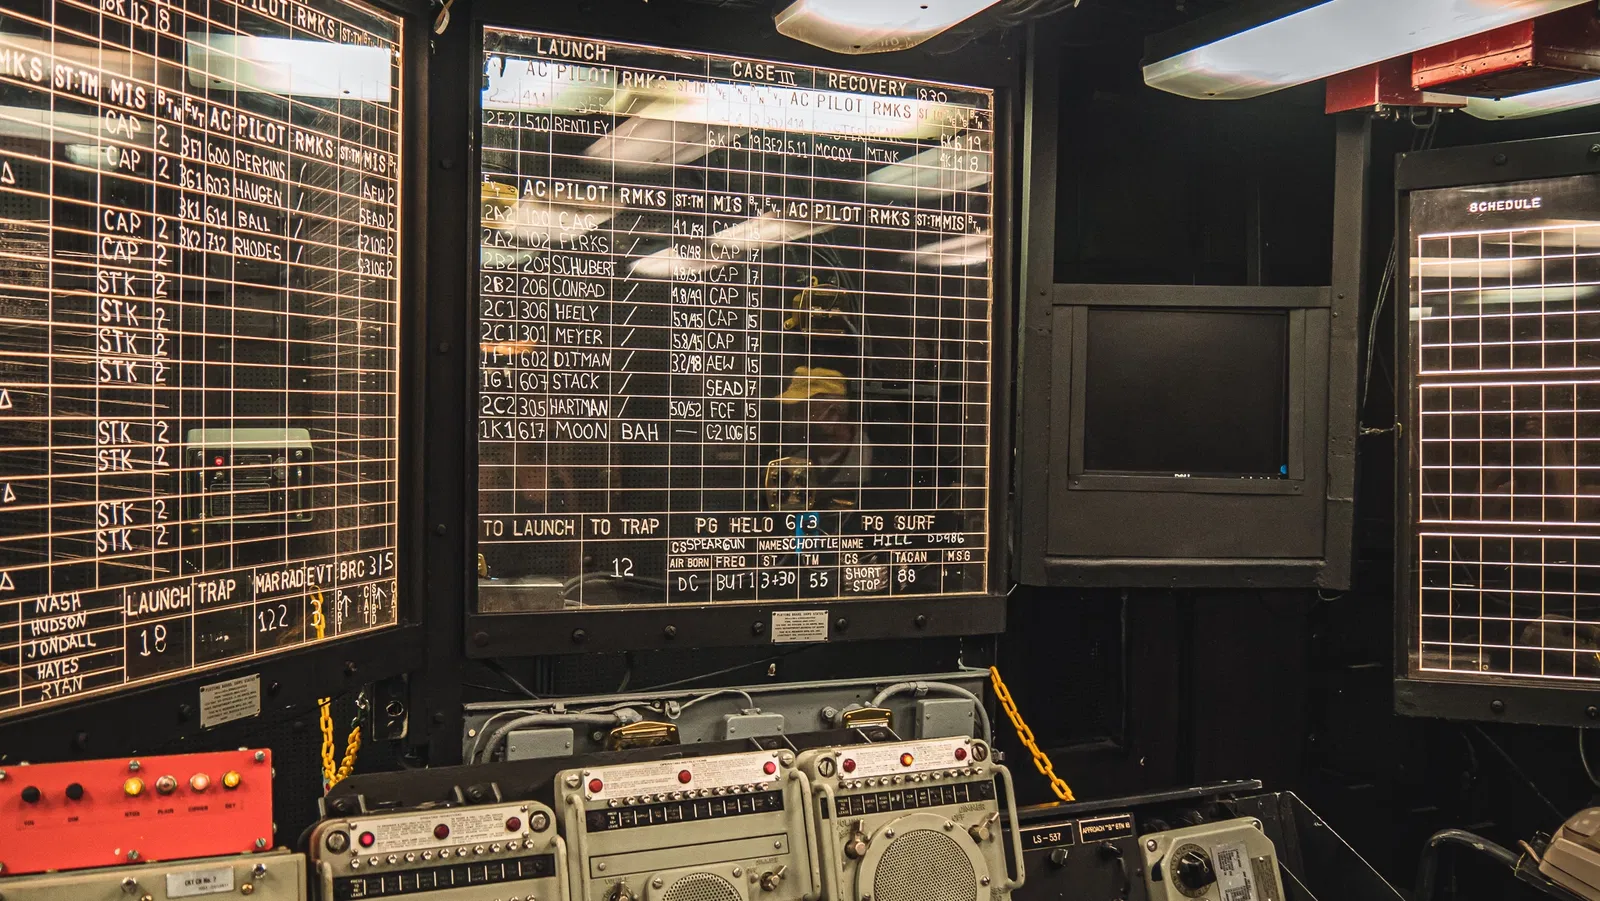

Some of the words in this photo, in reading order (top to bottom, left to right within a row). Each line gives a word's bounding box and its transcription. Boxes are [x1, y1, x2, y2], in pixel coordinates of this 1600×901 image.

[160, 9, 170, 32] 8
[297, 8, 335, 39] RMKS
[537, 37, 607, 62] LAUNCH
[733, 61, 775, 82] CASE
[829, 72, 907, 97] RECOVERY
[526, 60, 548, 78] AC
[558, 64, 610, 85] PILOT
[623, 71, 668, 89] RMKS
[791, 92, 809, 107] AC
[817, 94, 862, 113] PILOT
[873, 101, 912, 119] RMKS
[55, 64, 98, 97] ST:TM
[110, 79, 146, 109] MIS
[210, 108, 231, 131] AC
[239, 115, 285, 145] PILOT
[295, 131, 333, 158] RMKS
[340, 146, 361, 166] ST:TM
[364, 152, 386, 173] MIS
[106, 110, 141, 139] CAP
[157, 125, 169, 147] 2
[208, 143, 230, 166] 600
[236, 150, 285, 181] PERKINS
[526, 114, 550, 132] 510
[816, 143, 853, 163] MCCOY
[867, 147, 899, 163] MTNK
[970, 156, 979, 172] 8
[107, 146, 141, 172] CAP
[159, 157, 169, 179] 2
[206, 174, 230, 196] 603
[234, 178, 283, 207] HAUGEN
[360, 208, 386, 228] SEAD
[524, 179, 546, 198] AC
[555, 181, 608, 202] PILOT
[621, 187, 667, 207] RMKS
[676, 194, 704, 209] ST:TM
[714, 196, 742, 213] MIS
[789, 202, 809, 218] AC
[815, 204, 862, 222] PILOT
[870, 208, 910, 227] RMKS
[917, 214, 941, 228] ST:TM
[943, 215, 965, 231] MIS
[239, 212, 271, 232] BALL
[485, 205, 513, 221] 2A2
[713, 220, 740, 240] CAP
[105, 210, 141, 234] CAP
[157, 217, 168, 239] 2
[208, 234, 229, 254] 712
[234, 237, 282, 261] RHODES
[484, 229, 515, 248] 2A2
[560, 233, 609, 254] FIRKS
[711, 243, 740, 261] CAP
[102, 238, 139, 264] CAP
[157, 245, 167, 266] 2
[484, 252, 517, 270] 2B2
[552, 255, 617, 277] SCHUBERT
[710, 265, 739, 283] CAP
[99, 271, 136, 296] STK
[156, 274, 168, 295] 2
[521, 277, 548, 296] 206
[553, 278, 606, 298] CONRAD
[710, 287, 739, 306] CAP
[101, 298, 139, 326] STK
[156, 308, 168, 331] 2
[484, 300, 516, 317] 2C1
[522, 301, 548, 320] 306
[556, 303, 599, 322] HEELY
[708, 309, 738, 327] CAP
[100, 329, 138, 354] STK
[157, 334, 168, 356] 2
[482, 322, 516, 342] 2C1
[522, 325, 547, 343] 301
[556, 327, 603, 345] MEYER
[708, 332, 735, 350] CAP
[100, 359, 138, 383] STK
[155, 362, 166, 383] 2
[521, 351, 548, 367] 602
[706, 355, 735, 372] AEW
[483, 371, 514, 389] 1G1
[520, 373, 548, 391] 607
[553, 373, 600, 390] STACK
[707, 379, 744, 397] SEAD
[482, 396, 517, 415] 2C2
[520, 397, 546, 417] 305
[550, 398, 609, 417] HARTMAN
[711, 401, 735, 419] FCF
[99, 421, 132, 445] STK
[157, 421, 170, 443] 2
[481, 420, 515, 439] 1K1
[519, 422, 546, 440] 617
[556, 421, 608, 440] MOON
[622, 423, 659, 442] BAH
[99, 449, 133, 471] STK
[156, 447, 169, 467] 2
[98, 502, 134, 528] STK
[155, 500, 168, 520] 2
[484, 520, 504, 537] TO
[513, 519, 575, 537] LAUNCH
[592, 519, 611, 535] TO
[621, 518, 660, 535] TRAP
[697, 518, 718, 534] PG
[732, 517, 774, 534] HELO
[786, 514, 818, 530] 613
[863, 516, 884, 531] PG
[896, 515, 936, 531] SURF
[97, 529, 133, 553] STK
[156, 525, 168, 546] 2
[782, 538, 839, 550] SCHOTTLE
[842, 539, 864, 549] NAME
[873, 534, 913, 547] HILL
[341, 560, 365, 581] BRC
[611, 558, 634, 578] 12
[687, 557, 710, 568] BORN
[716, 556, 746, 568] FREQ
[763, 556, 778, 567] ST
[805, 554, 820, 566] TM
[844, 553, 859, 565] CS
[895, 552, 928, 563] TACAN
[307, 564, 334, 587] EVT
[678, 574, 699, 592] DC
[716, 573, 745, 591] BUT
[761, 572, 796, 589] 3+30
[810, 572, 829, 588] 55
[845, 567, 881, 581] SHORT
[898, 569, 916, 583] 88
[853, 579, 881, 592] STOP
[36, 592, 82, 614] NASH
[127, 586, 191, 617] LAUNCH
[198, 579, 236, 604] TRAP
[31, 611, 87, 637] HUDSON
[259, 604, 289, 633] 122
[310, 600, 322, 627] 3
[28, 633, 97, 659] JONDALL
[140, 625, 167, 657] 18
[38, 658, 79, 680] HAYES
[41, 675, 83, 701] RYAN
